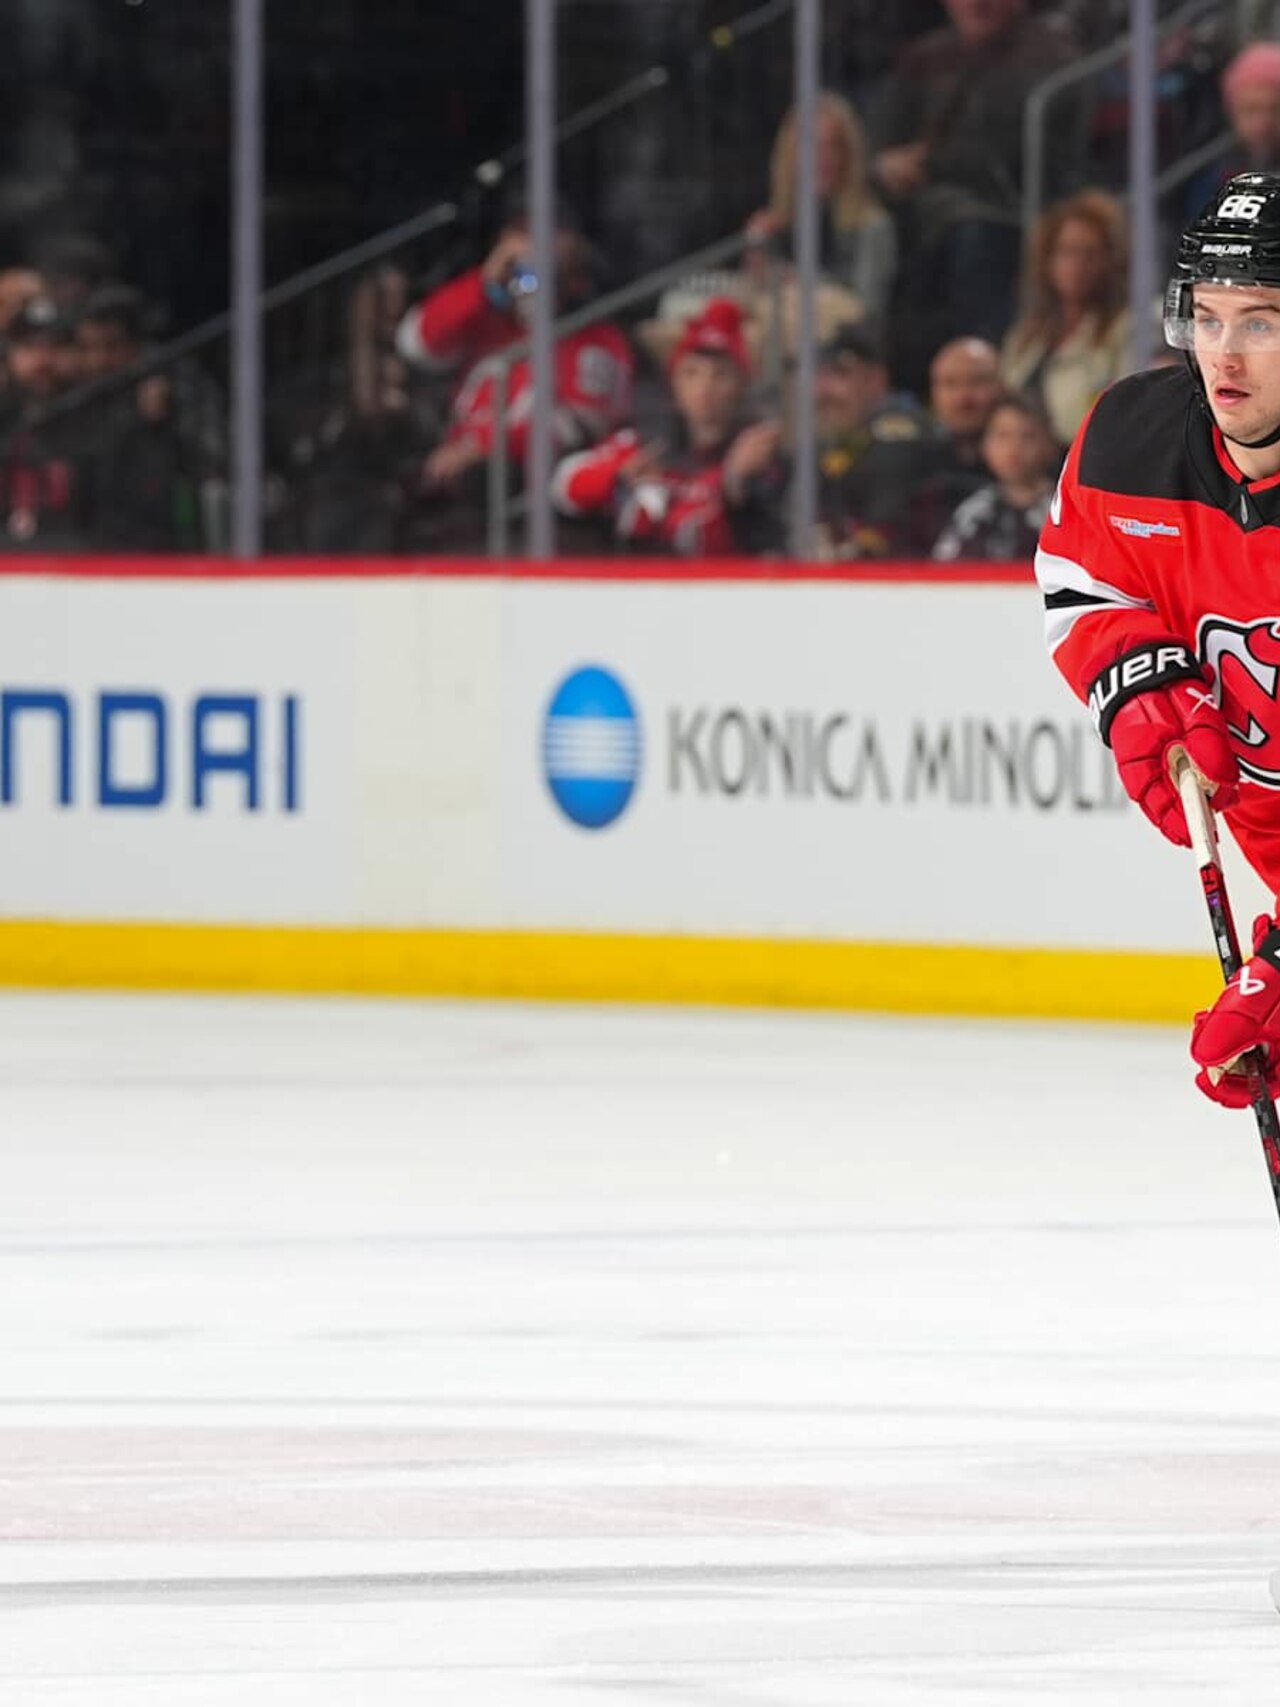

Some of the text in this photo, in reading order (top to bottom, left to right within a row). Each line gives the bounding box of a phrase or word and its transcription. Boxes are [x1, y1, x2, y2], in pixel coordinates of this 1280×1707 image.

[1217, 194, 1267, 220] 86
[1201, 244, 1252, 258] BAUER
[666, 706, 892, 802] KONICA
